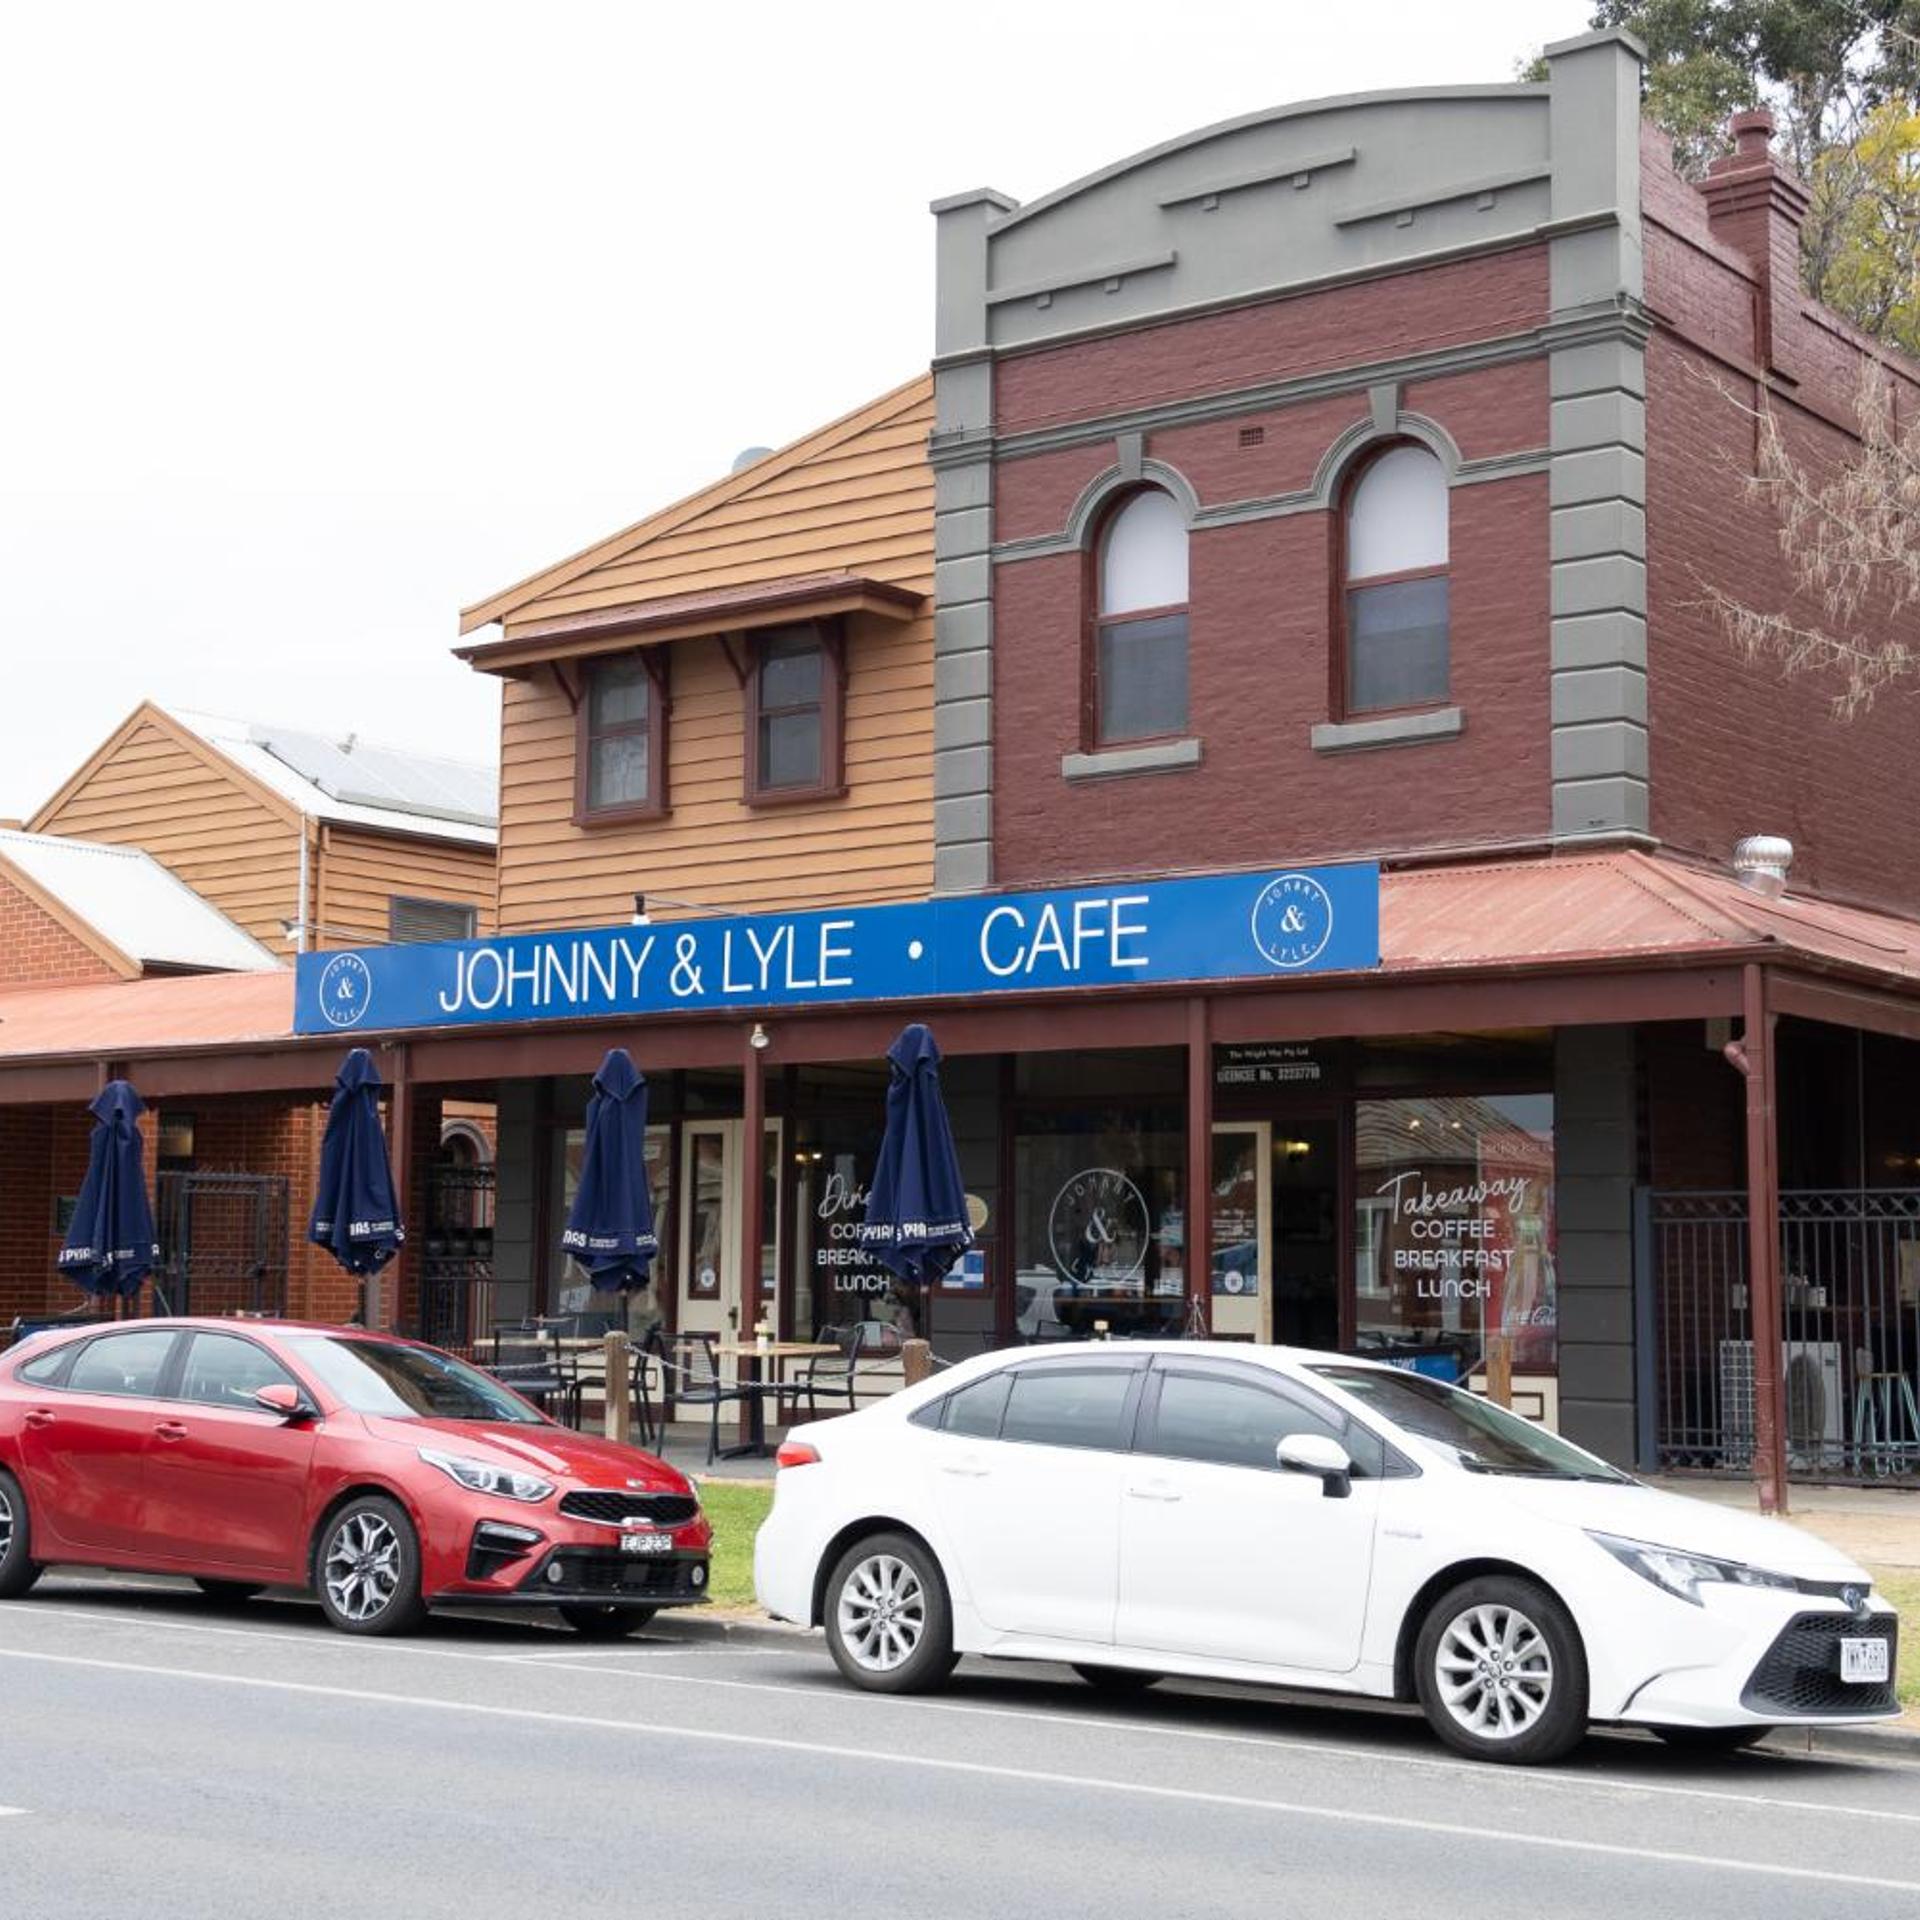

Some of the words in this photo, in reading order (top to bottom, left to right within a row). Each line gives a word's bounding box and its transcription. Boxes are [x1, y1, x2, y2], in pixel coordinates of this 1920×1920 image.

[1281, 905, 1304, 932] &
[437, 936, 655, 1013] JOHNNY
[670, 933, 704, 996] &
[723, 921, 854, 992] LYLE
[980, 895, 1149, 976] CAFE
[337, 976, 353, 998] &
[1376, 1170, 1532, 1225] Takeaway
[1085, 1207, 1120, 1243] &
[1410, 1219, 1496, 1239] COFFEE
[1394, 1249, 1516, 1269] BREAKFAST
[834, 1274, 891, 1292] LUNCH
[1417, 1278, 1492, 1299] LUNCH
